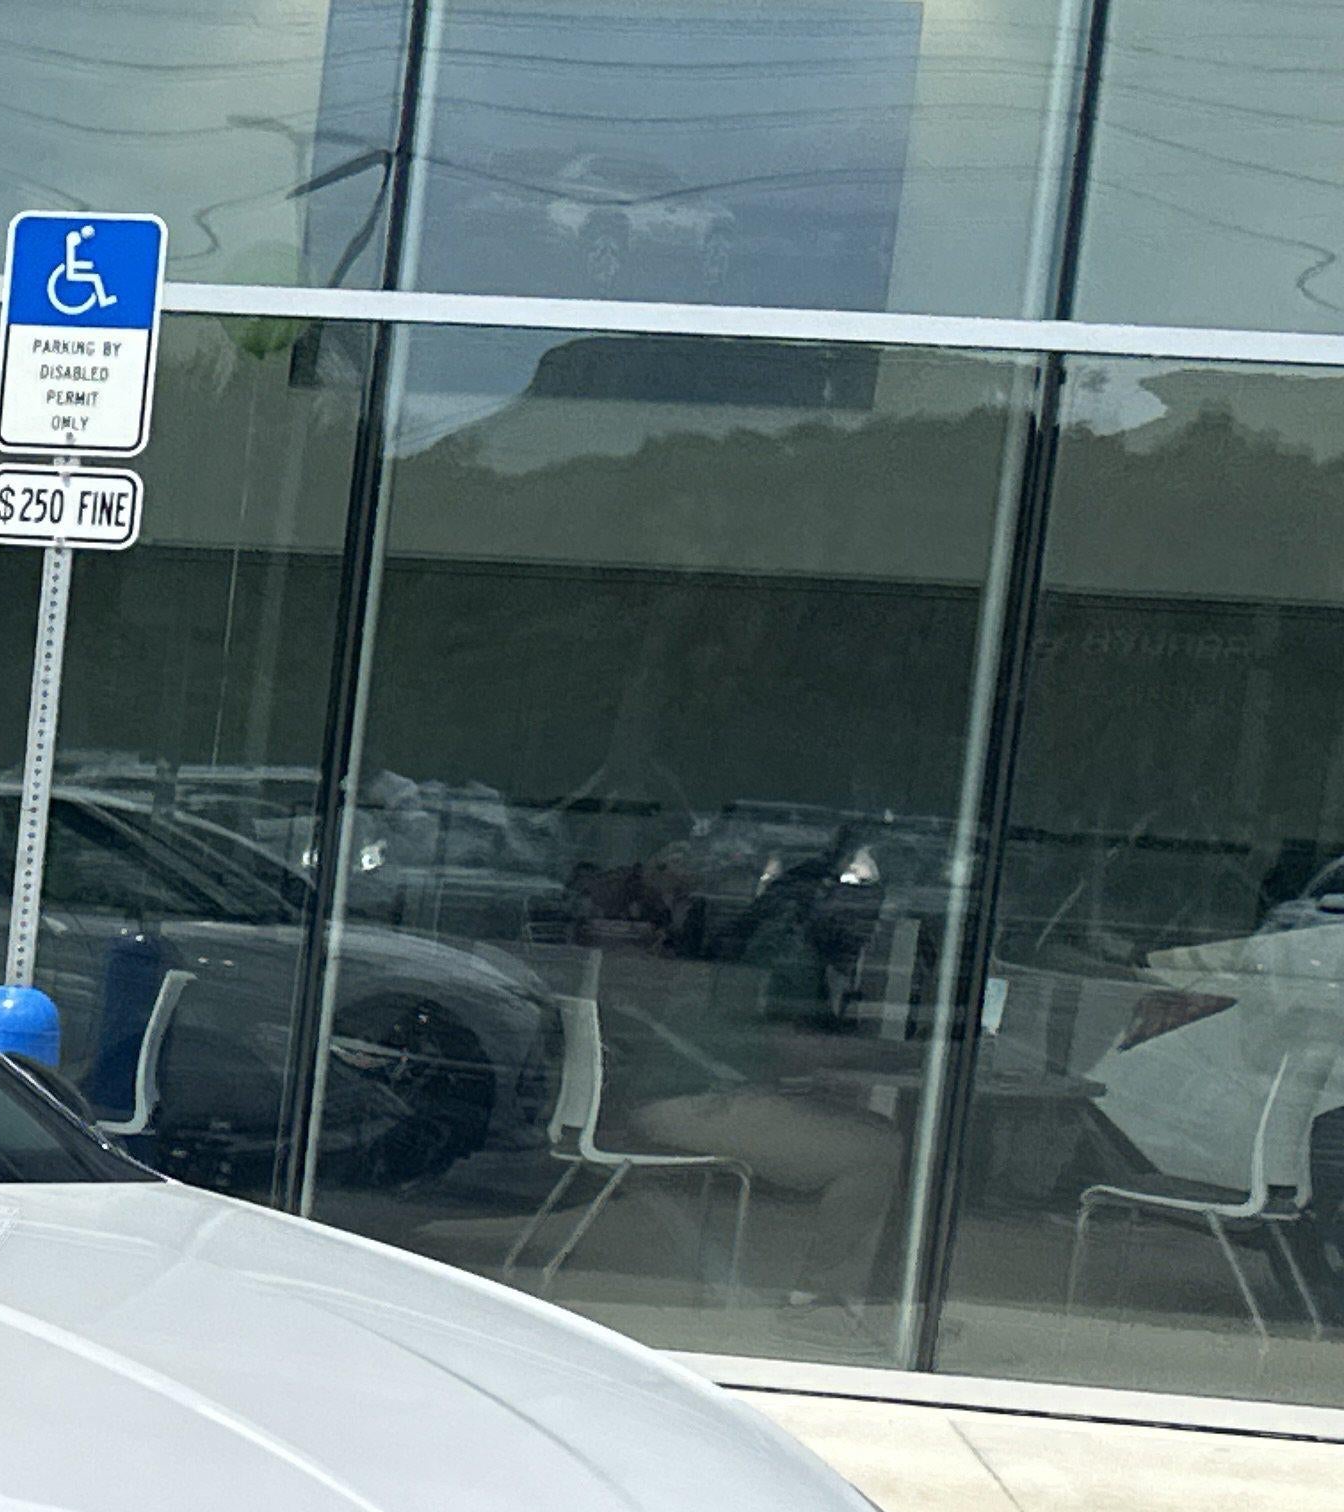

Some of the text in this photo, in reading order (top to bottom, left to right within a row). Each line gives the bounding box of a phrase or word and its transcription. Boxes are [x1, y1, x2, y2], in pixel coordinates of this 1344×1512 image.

[32, 338, 121, 356] PARKING BY
[39, 364, 109, 381] DISABLED
[46, 390, 99, 406] PERMIT
[51, 415, 90, 431] ONLY
[77, 490, 129, 528] FINE
